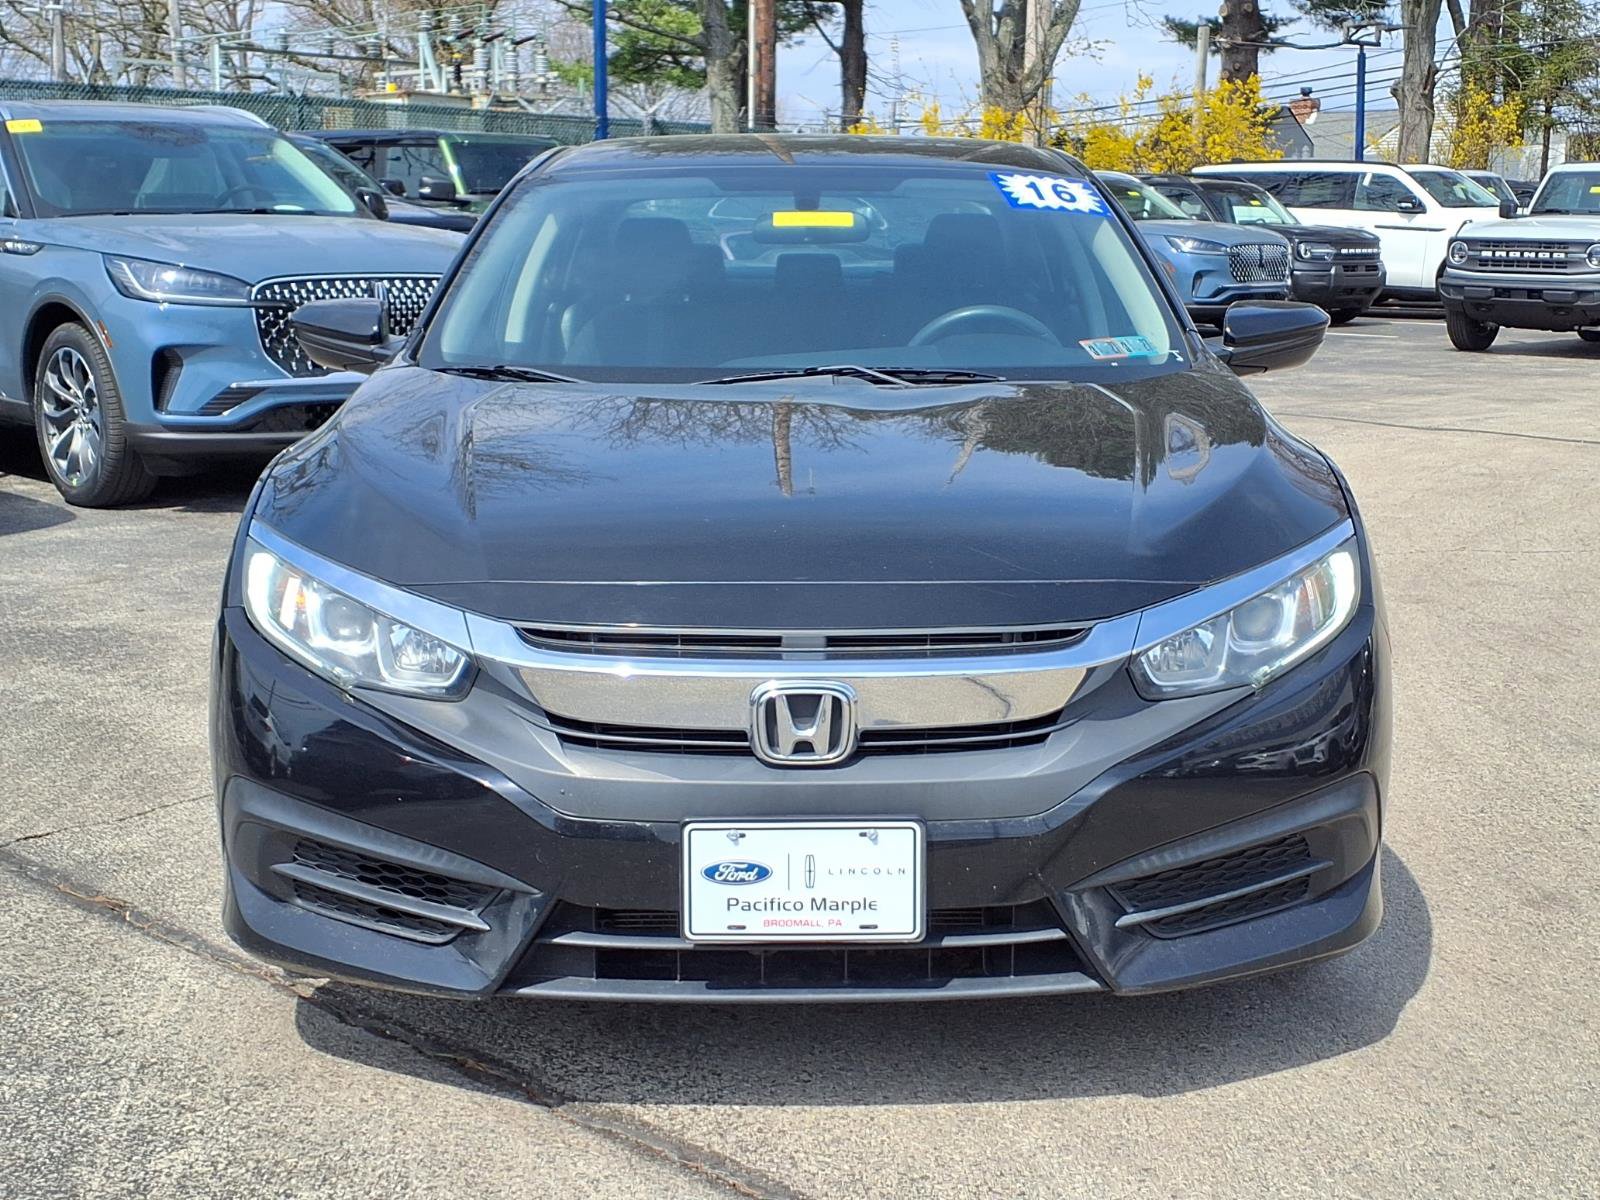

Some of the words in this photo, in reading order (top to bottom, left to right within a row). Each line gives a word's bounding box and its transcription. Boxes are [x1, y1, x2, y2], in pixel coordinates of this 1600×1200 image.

[1025, 181, 1077, 203] 16
[1481, 250, 1566, 259] BRONCO
[714, 861, 758, 882] Ford
[828, 867, 906, 876] LINCOLN
[727, 897, 804, 912] Pacifico
[810, 897, 878, 915] Marple
[827, 918, 842, 928] PA
